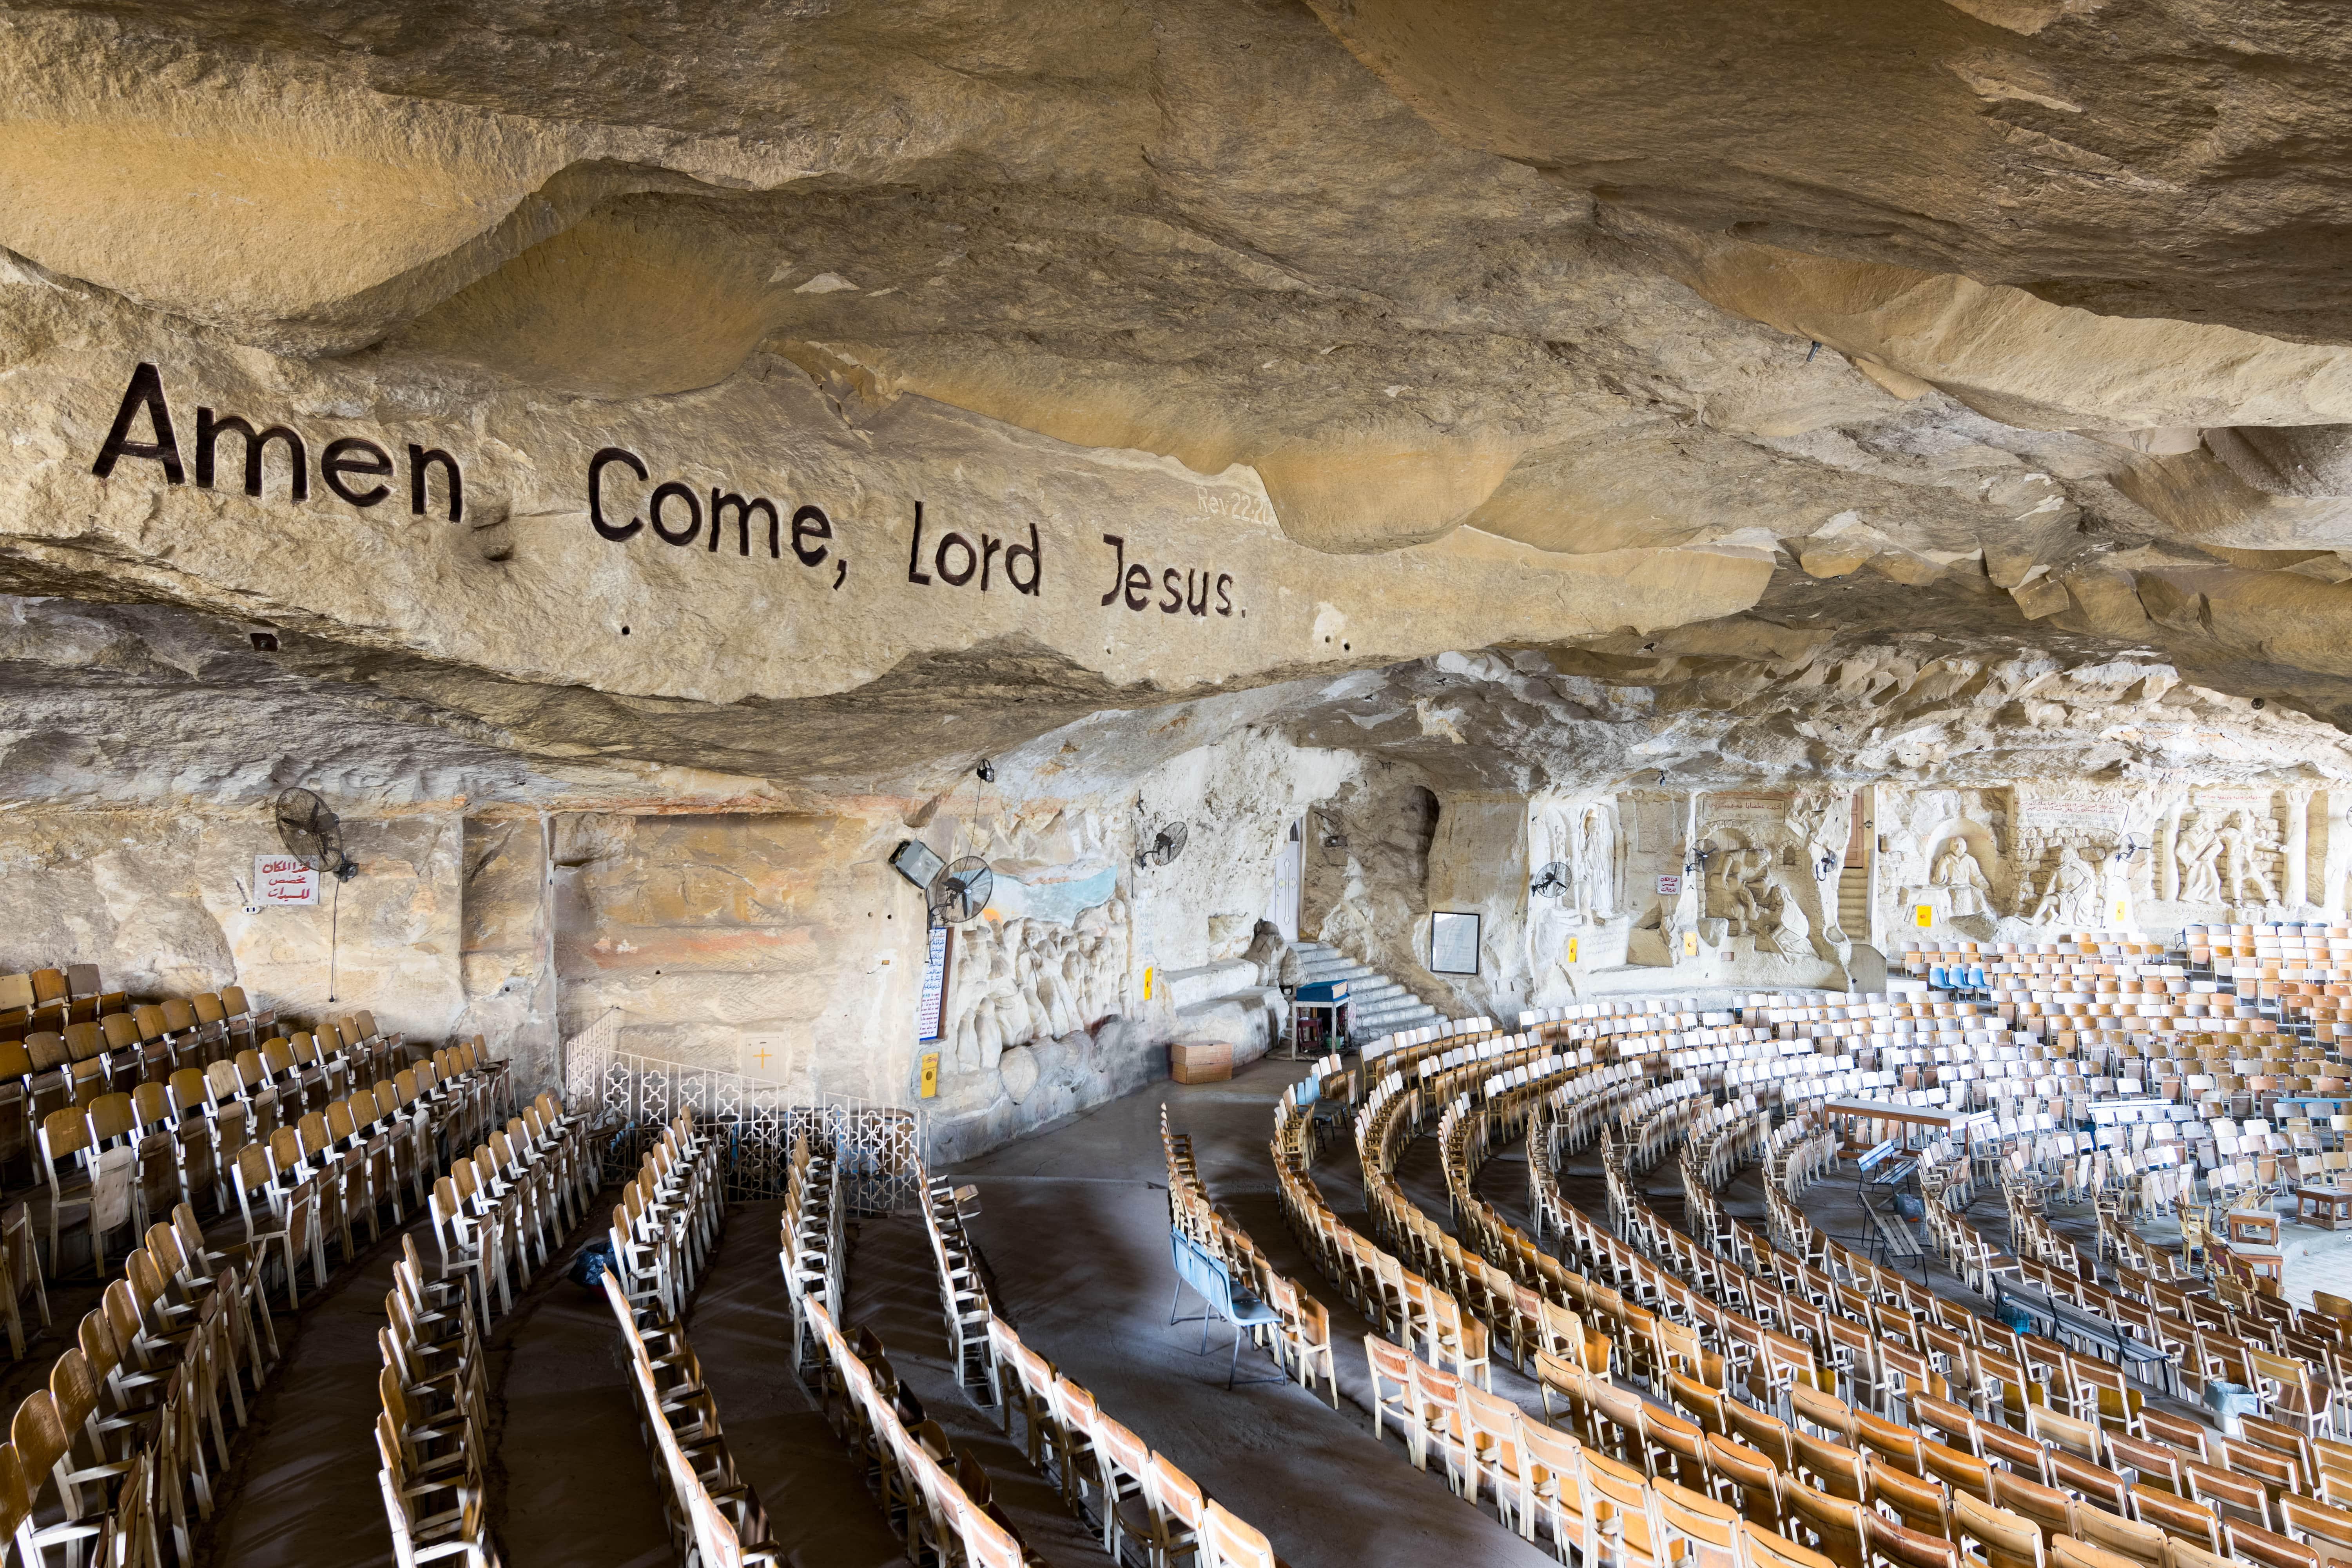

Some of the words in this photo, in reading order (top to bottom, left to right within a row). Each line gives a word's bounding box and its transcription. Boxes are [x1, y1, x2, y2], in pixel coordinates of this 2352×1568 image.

[92, 362, 463, 523] Amen
[588, 448, 846, 590] Come,
[909, 501, 1041, 596] Lord
[1102, 535, 1246, 619] Jesus.
[1195, 486, 1229, 516] Rev
[262, 860, 291, 874] المكان
[269, 875, 307, 886] مخصص
[268, 886, 310, 902] للسيدات
